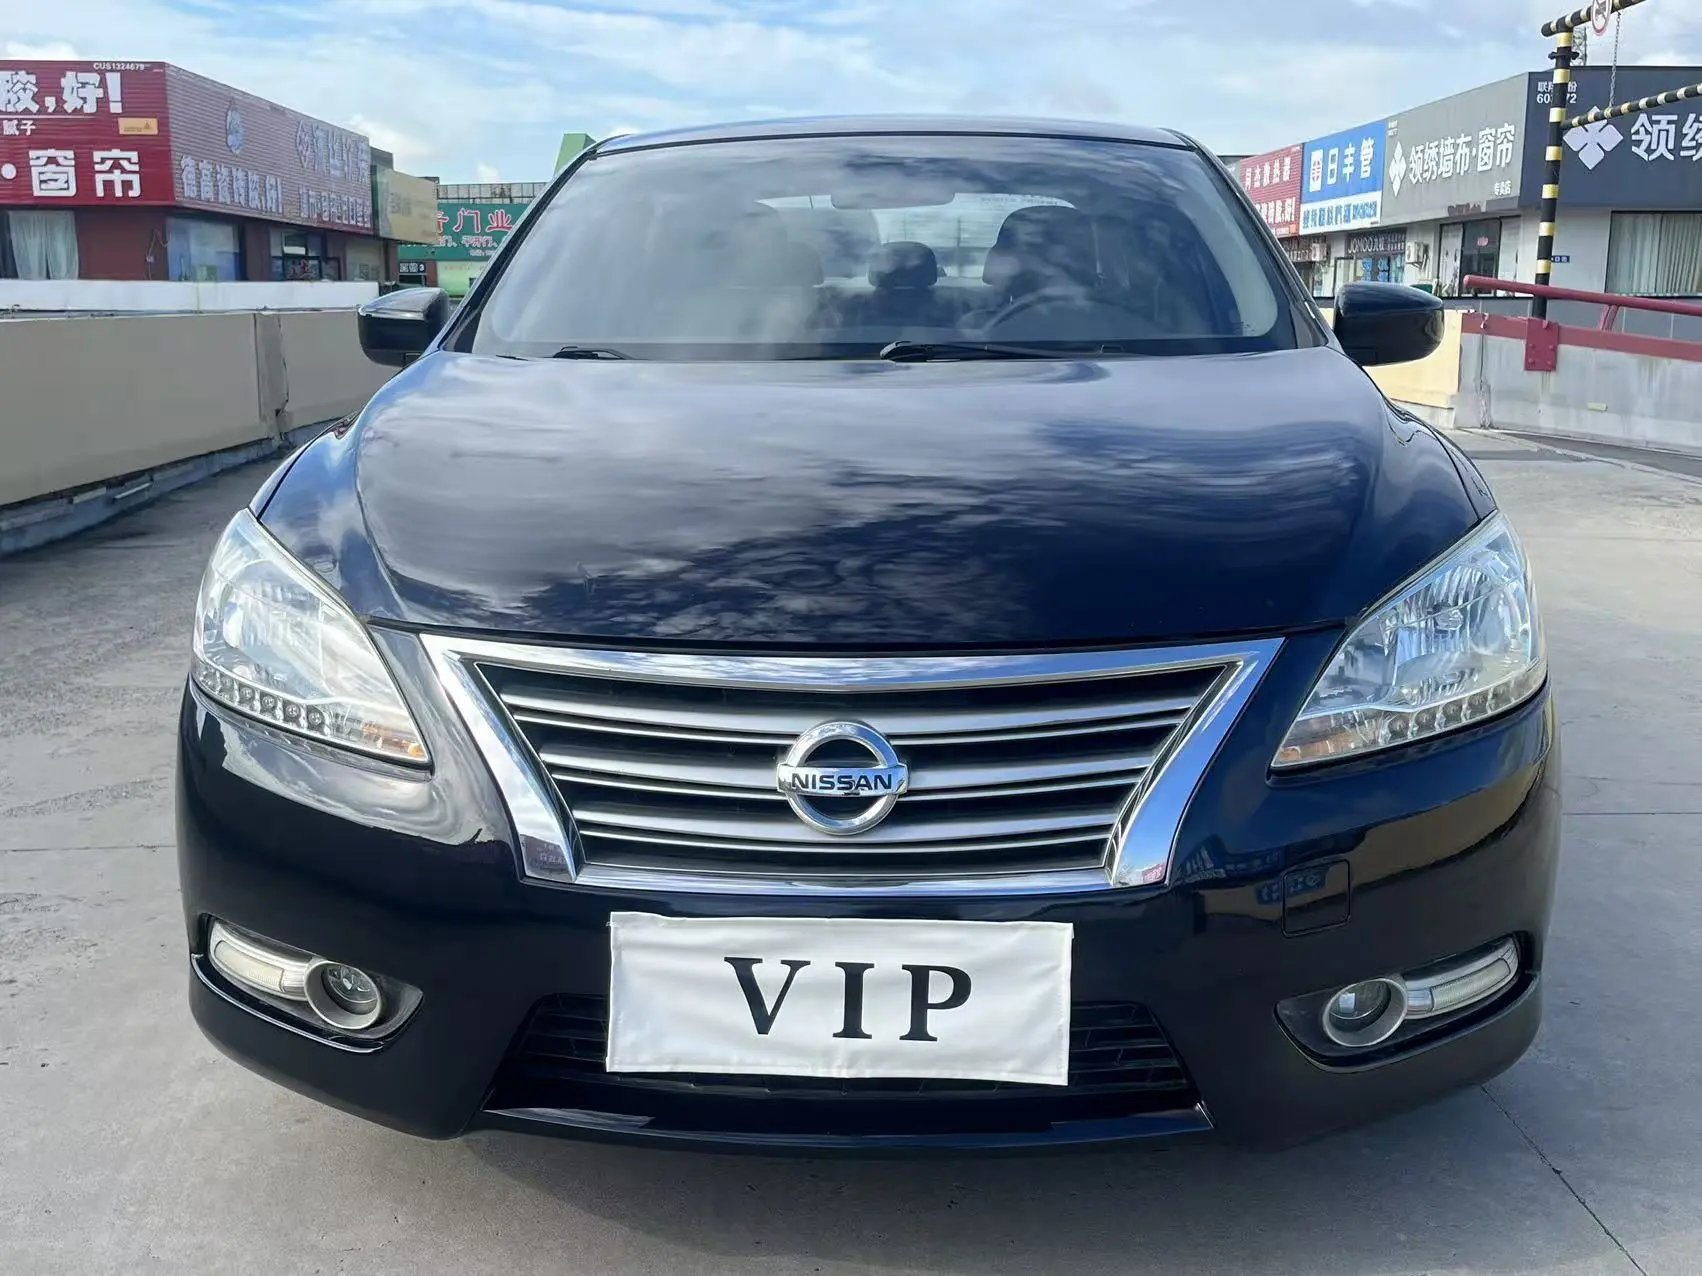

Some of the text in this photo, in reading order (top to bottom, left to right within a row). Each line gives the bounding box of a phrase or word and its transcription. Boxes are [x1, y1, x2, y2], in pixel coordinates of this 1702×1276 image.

[1326, 136, 1375, 185] 日丰管
[791, 773, 892, 791] NISSAN
[723, 956, 972, 1043] VIP
